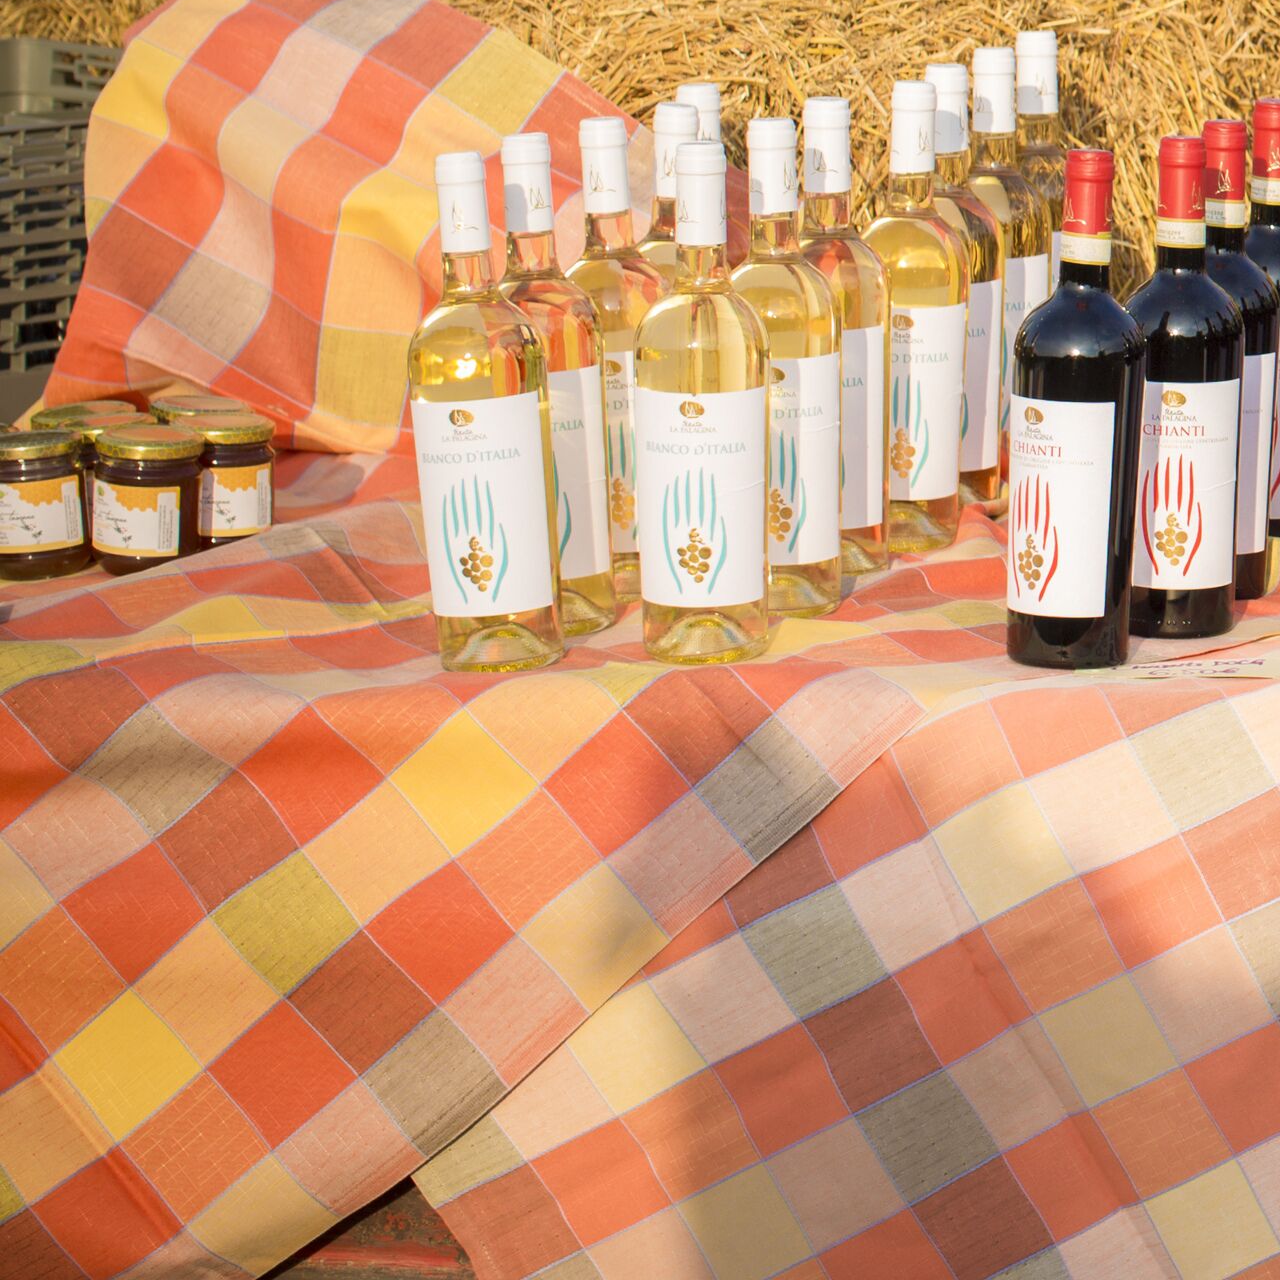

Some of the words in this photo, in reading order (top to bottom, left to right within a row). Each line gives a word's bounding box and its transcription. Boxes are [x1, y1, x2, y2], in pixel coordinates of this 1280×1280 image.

[1005, 302, 1033, 312] TALIA
[551, 417, 585, 433] TALIA
[1143, 424, 1205, 437] CHIANTI
[421, 452, 461, 465] BIANCO
[466, 447, 522, 464] D'ITALIA
[645, 440, 690, 456] BIANCO
[694, 441, 747, 456] D'ITALIA
[1013, 440, 1062, 458] CHIANTI
